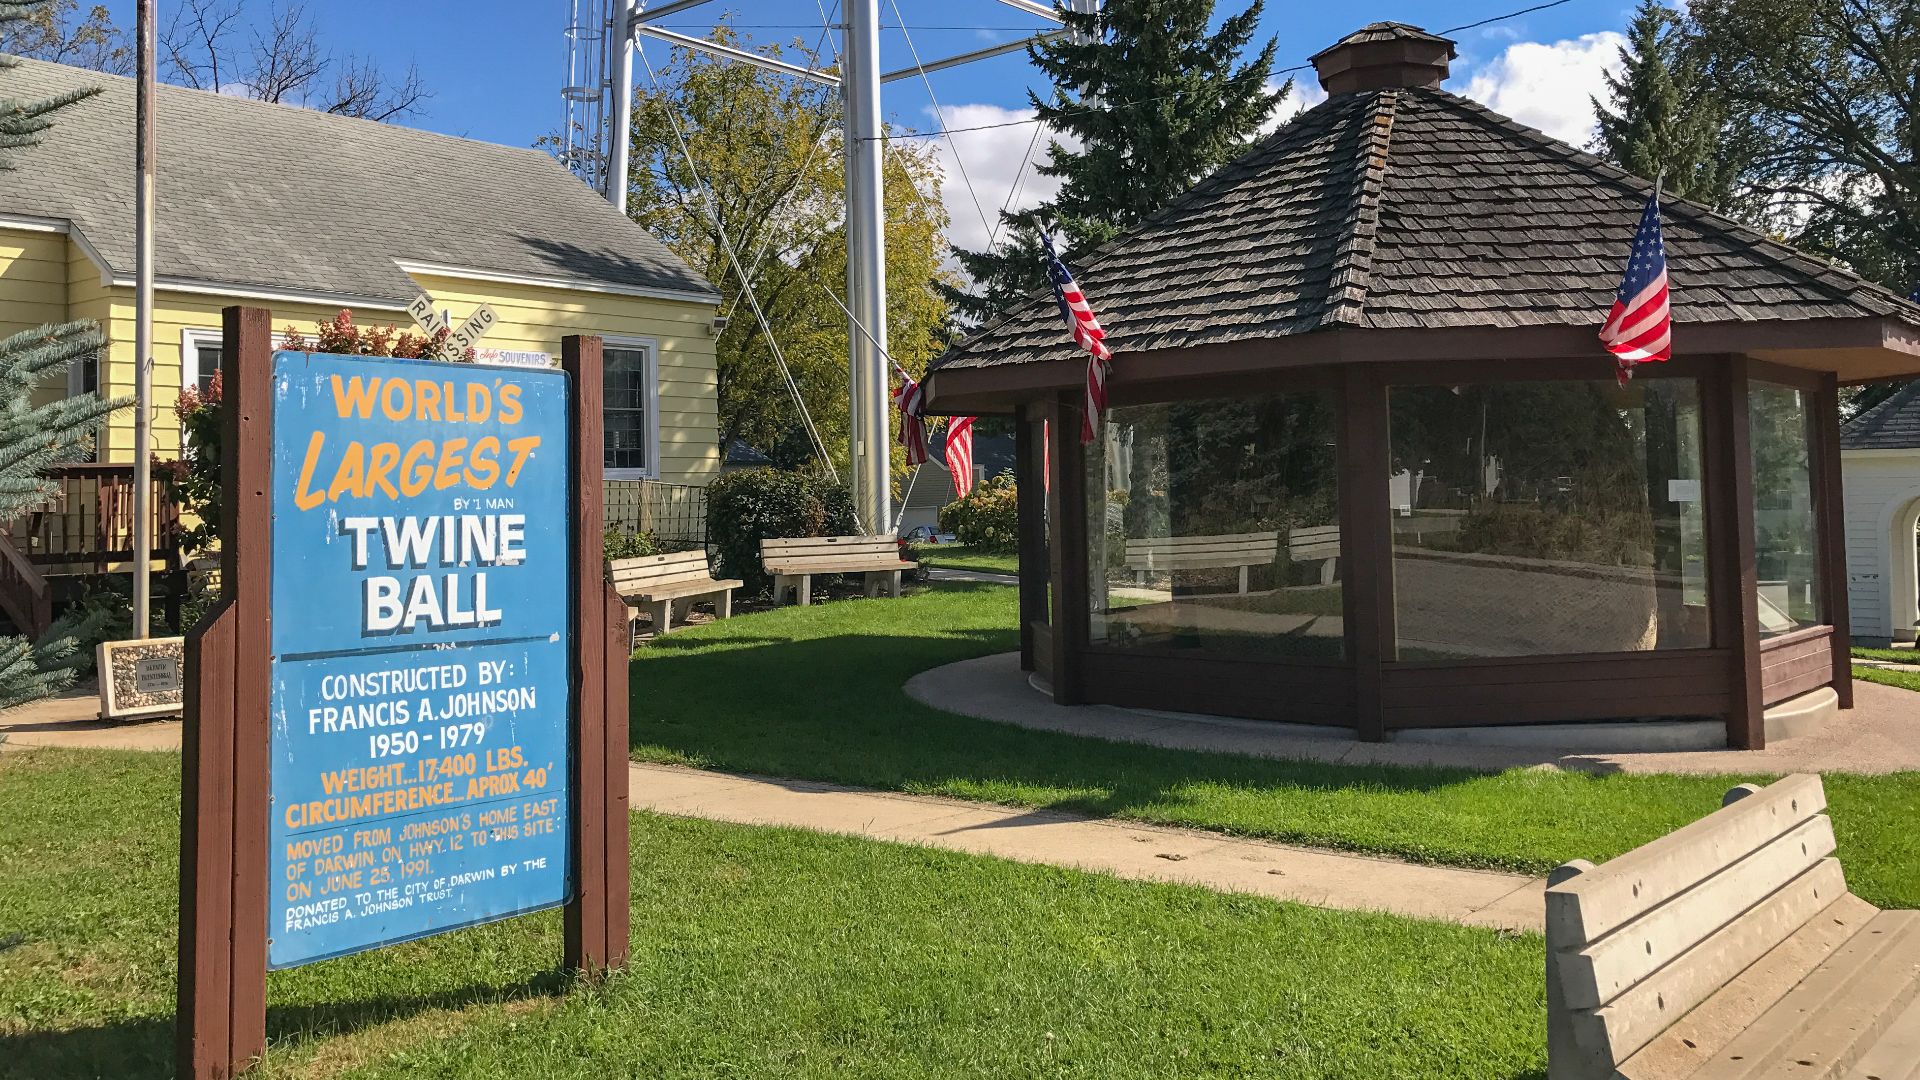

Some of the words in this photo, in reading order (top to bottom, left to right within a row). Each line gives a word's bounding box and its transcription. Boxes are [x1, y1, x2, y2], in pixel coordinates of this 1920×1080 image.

[412, 301, 441, 332] RAI
[500, 351, 546, 366] SOUVENIRS
[330, 375, 524, 425] WORLD'S
[294, 431, 541, 512] LARGEST
[454, 496, 470, 511] BY
[486, 497, 514, 510] MAN
[338, 514, 526, 571] TWINE
[361, 572, 503, 638] BALL
[321, 664, 467, 701] CONSTRUCTED
[308, 699, 410, 735] FRANCIS
[486, 745, 529, 773] LBS.
[466, 771, 520, 801] APROX
[286, 834, 344, 861] MOVED
[353, 827, 391, 850] FROM
[399, 812, 472, 842] JOHNSON'S
[479, 806, 517, 828] HOME
[523, 799, 558, 820] EAST
[286, 861, 307, 881] OF
[314, 850, 374, 876] DARWIN
[381, 845, 401, 863] ON
[450, 834, 464, 852] 12
[471, 830, 487, 848] TO
[492, 824, 519, 842] THIS
[286, 881, 313, 902] ON
[320, 870, 363, 895] JUNE
[286, 897, 347, 921] DONATED
[355, 892, 372, 906] TO
[377, 887, 399, 902] THE
[405, 881, 429, 896] CITY
[450, 868, 495, 887] DARWIN
[501, 863, 518, 877] BY
[523, 857, 547, 872] THE
[285, 912, 340, 934] FRANCIS
[360, 896, 413, 917] JOHNSON
